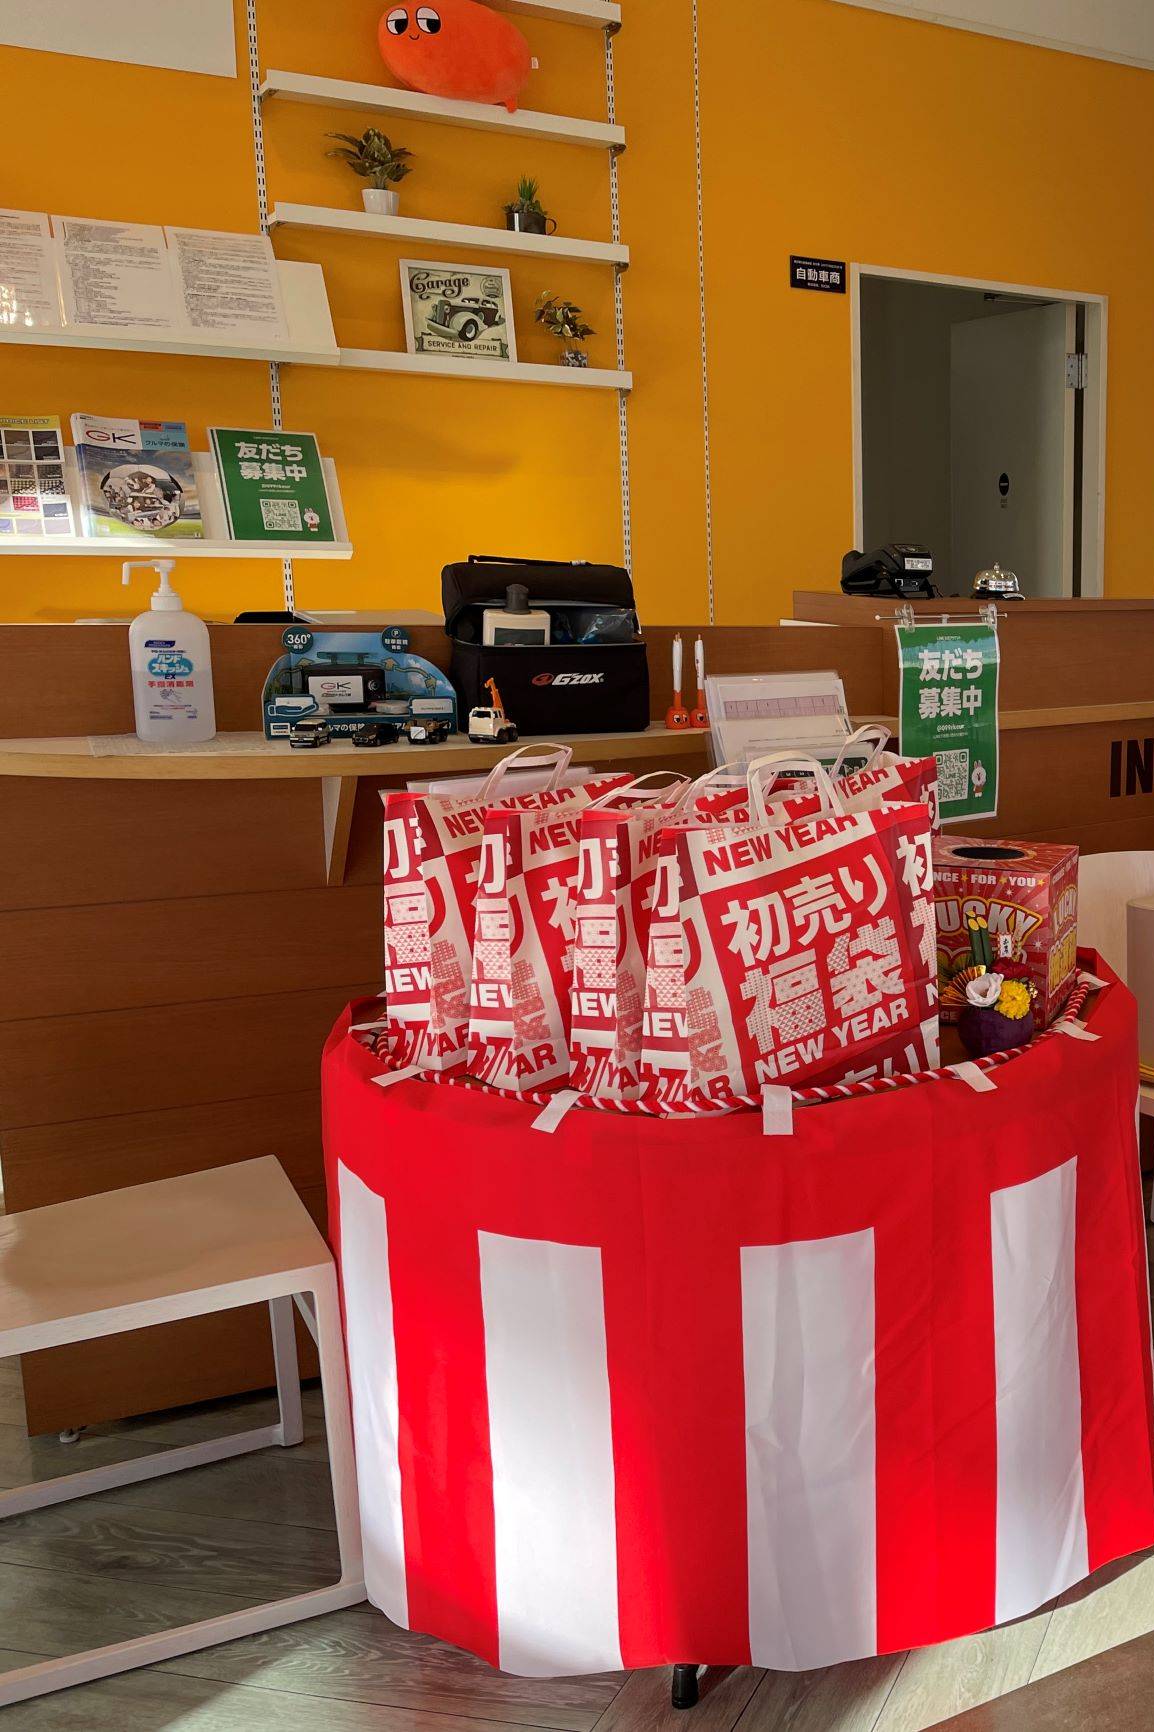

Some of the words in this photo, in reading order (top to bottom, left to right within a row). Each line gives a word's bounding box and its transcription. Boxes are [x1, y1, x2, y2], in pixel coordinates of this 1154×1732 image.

[410, 272, 469, 300] Garage
[796, 267, 840, 285] 自動車商
[427, 340, 455, 349] SERVICE
[473, 343, 497, 352] REPAIR
[85, 430, 136, 445] GK
[235, 441, 304, 461] 友だち
[239, 462, 308, 482] 募集中
[287, 633, 311, 645] 360°
[918, 647, 983, 682] 友だち
[320, 681, 352, 690] GK
[918, 684, 983, 720] 募集中
[702, 832, 772, 877] NEW
[773, 814, 859, 852] YEAR
[970, 873, 997, 885] FOR
[1008, 876, 1037, 887] YOU
[720, 853, 890, 969] 初売り
[739, 915, 906, 1054] 福袋
[753, 1032, 826, 1086] NEW
[831, 997, 910, 1050] YEAR
